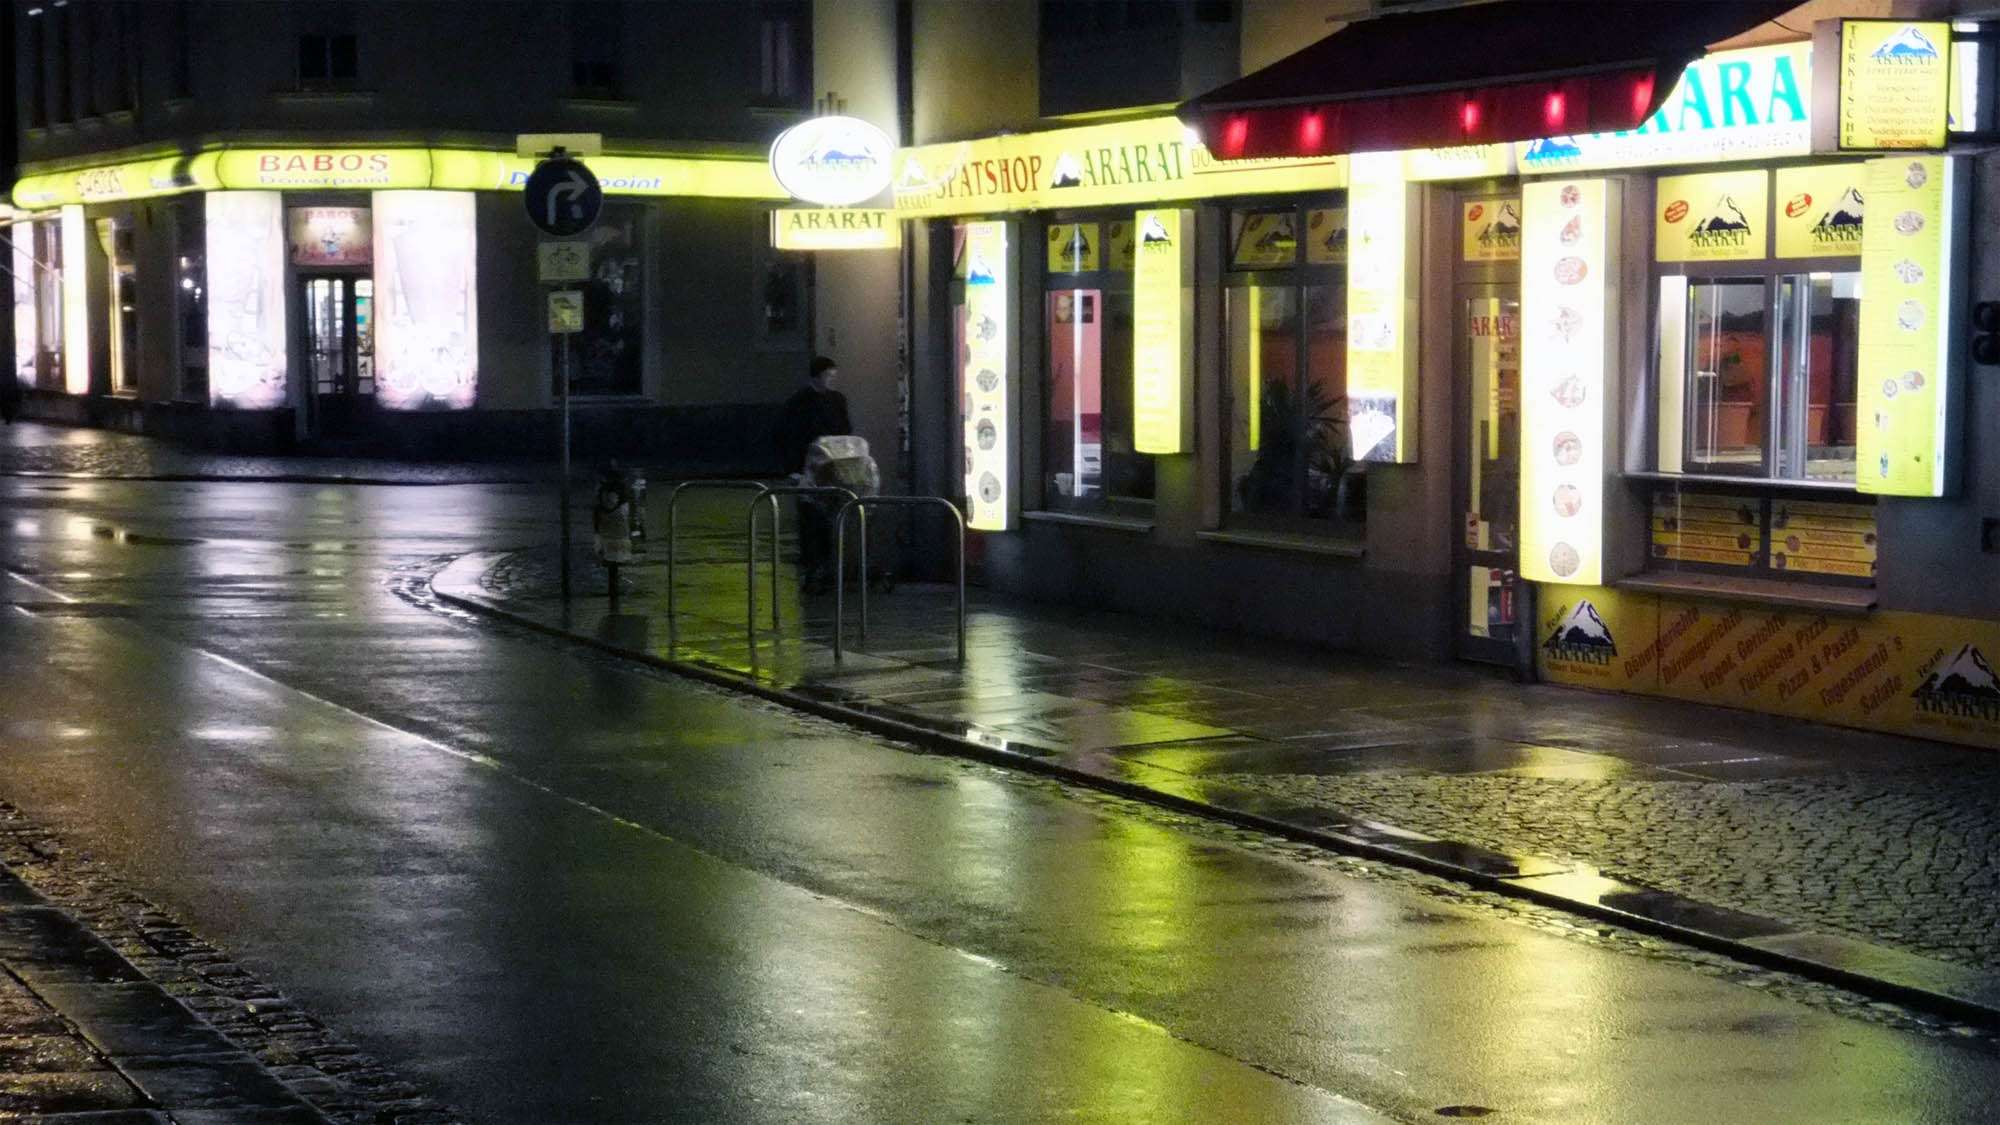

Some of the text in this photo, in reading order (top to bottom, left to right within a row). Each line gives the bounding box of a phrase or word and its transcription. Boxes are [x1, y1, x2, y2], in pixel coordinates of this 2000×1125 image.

[259, 153, 390, 173] BABOS
[1083, 141, 1185, 188] ARARAT
[789, 211, 887, 230] ARARAT
[1777, 668, 1810, 702] Pizza
